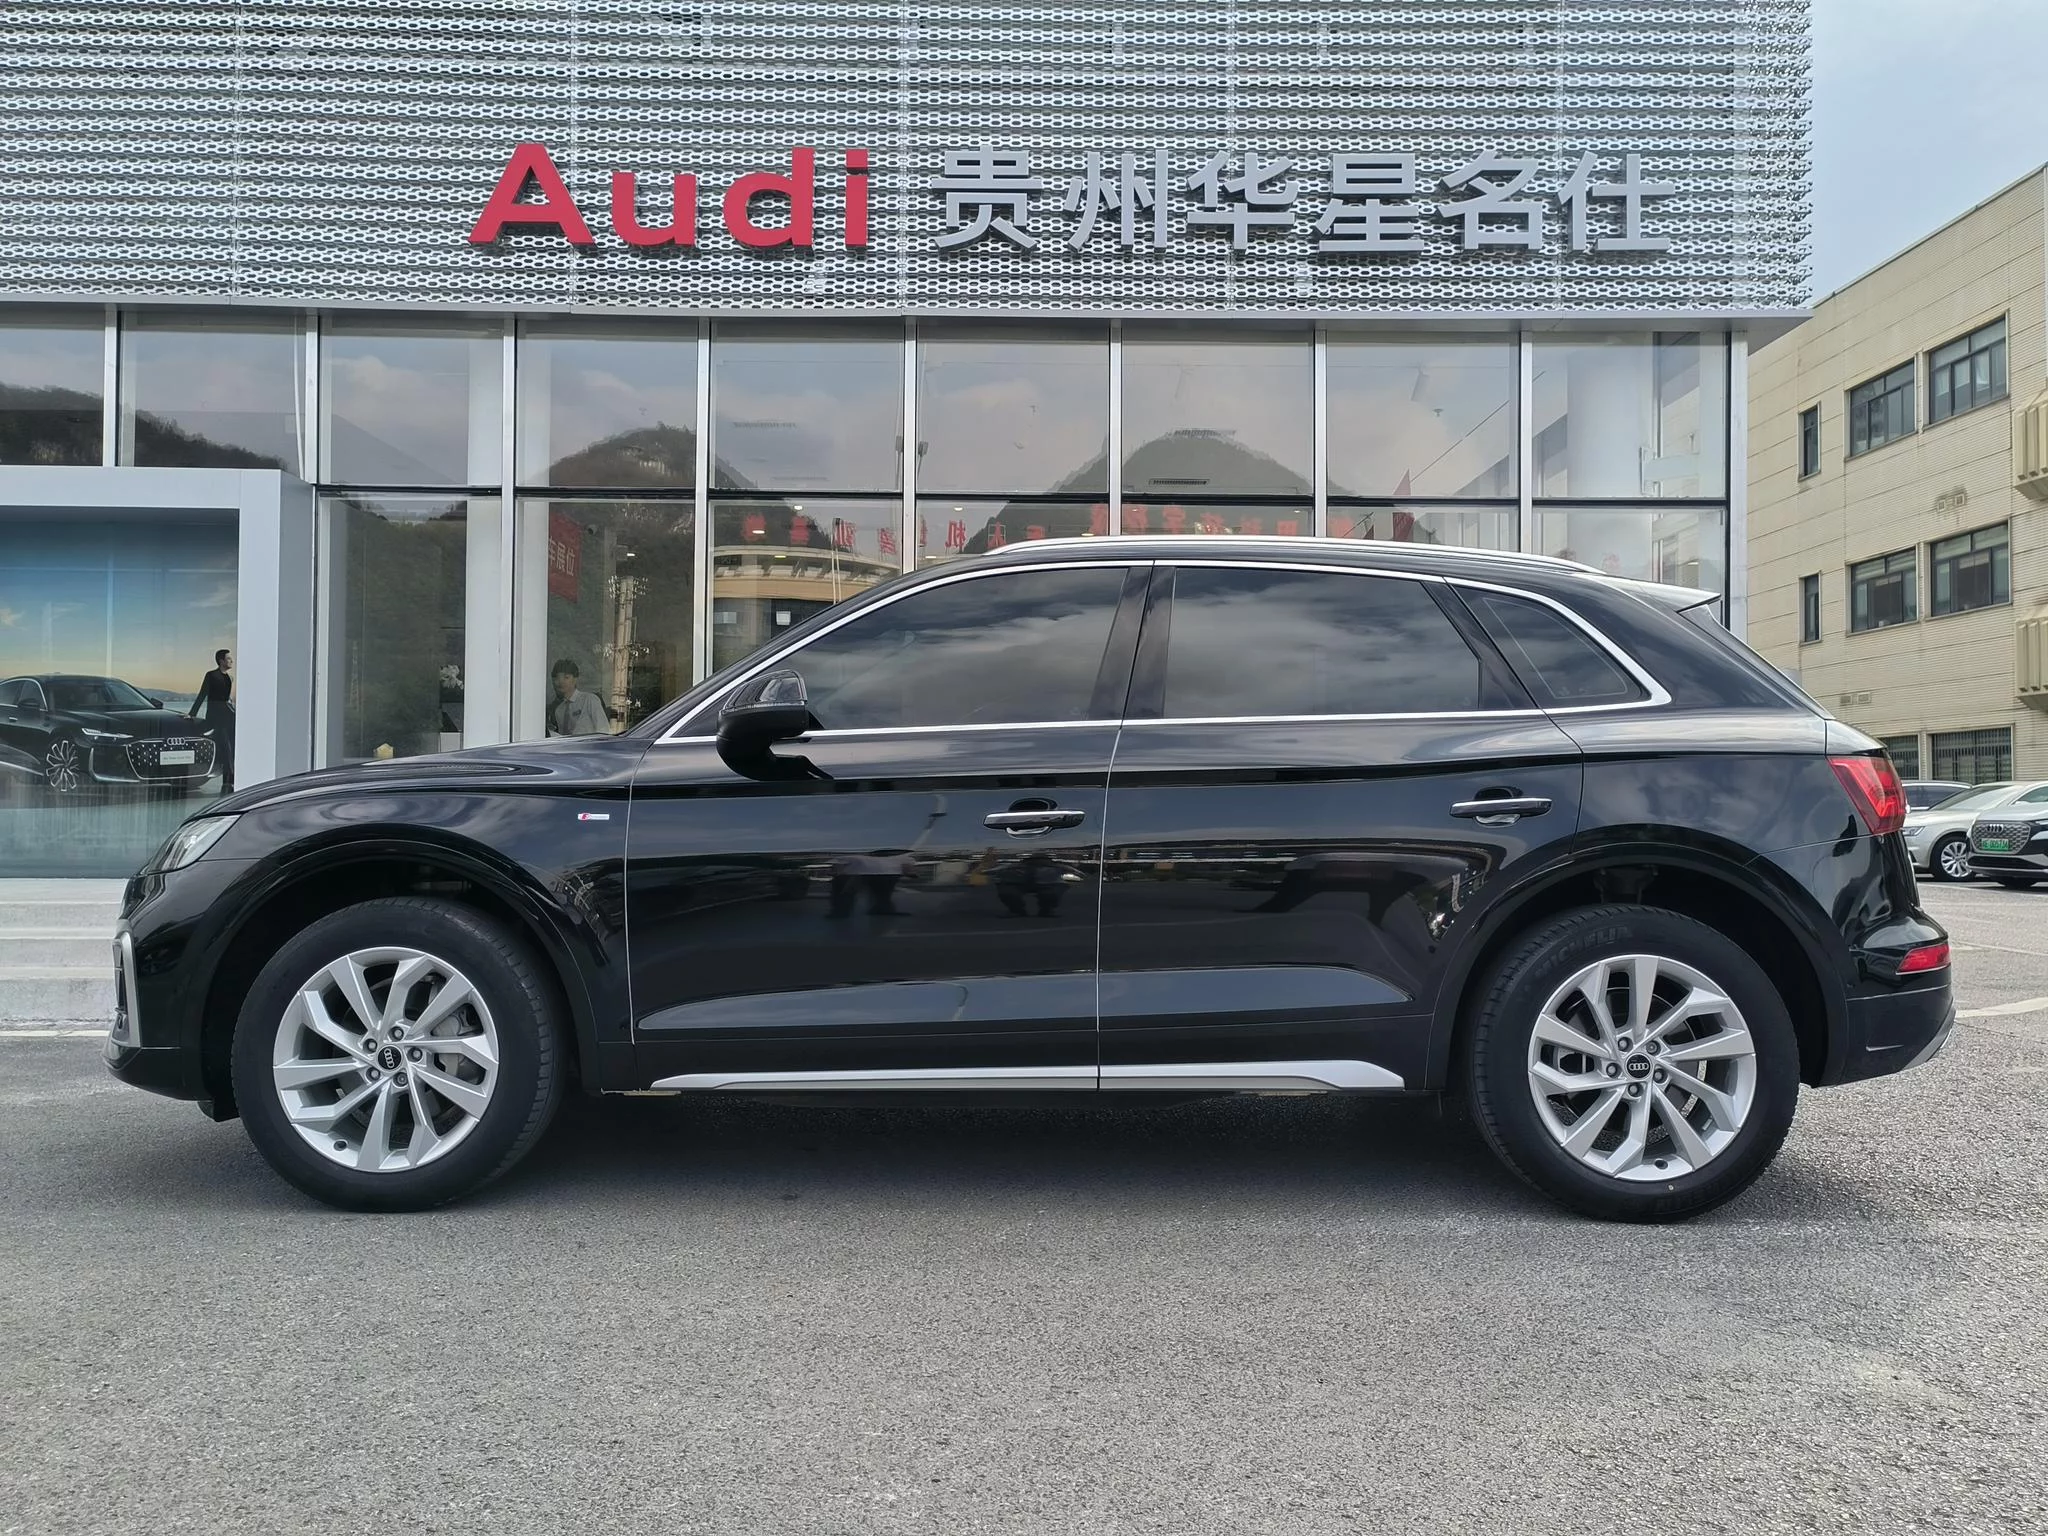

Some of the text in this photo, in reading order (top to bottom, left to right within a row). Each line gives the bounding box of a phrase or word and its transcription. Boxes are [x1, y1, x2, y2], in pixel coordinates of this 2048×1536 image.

[467, 143, 870, 248] Audi
[930, 144, 1677, 251] 贵州华星名仕
